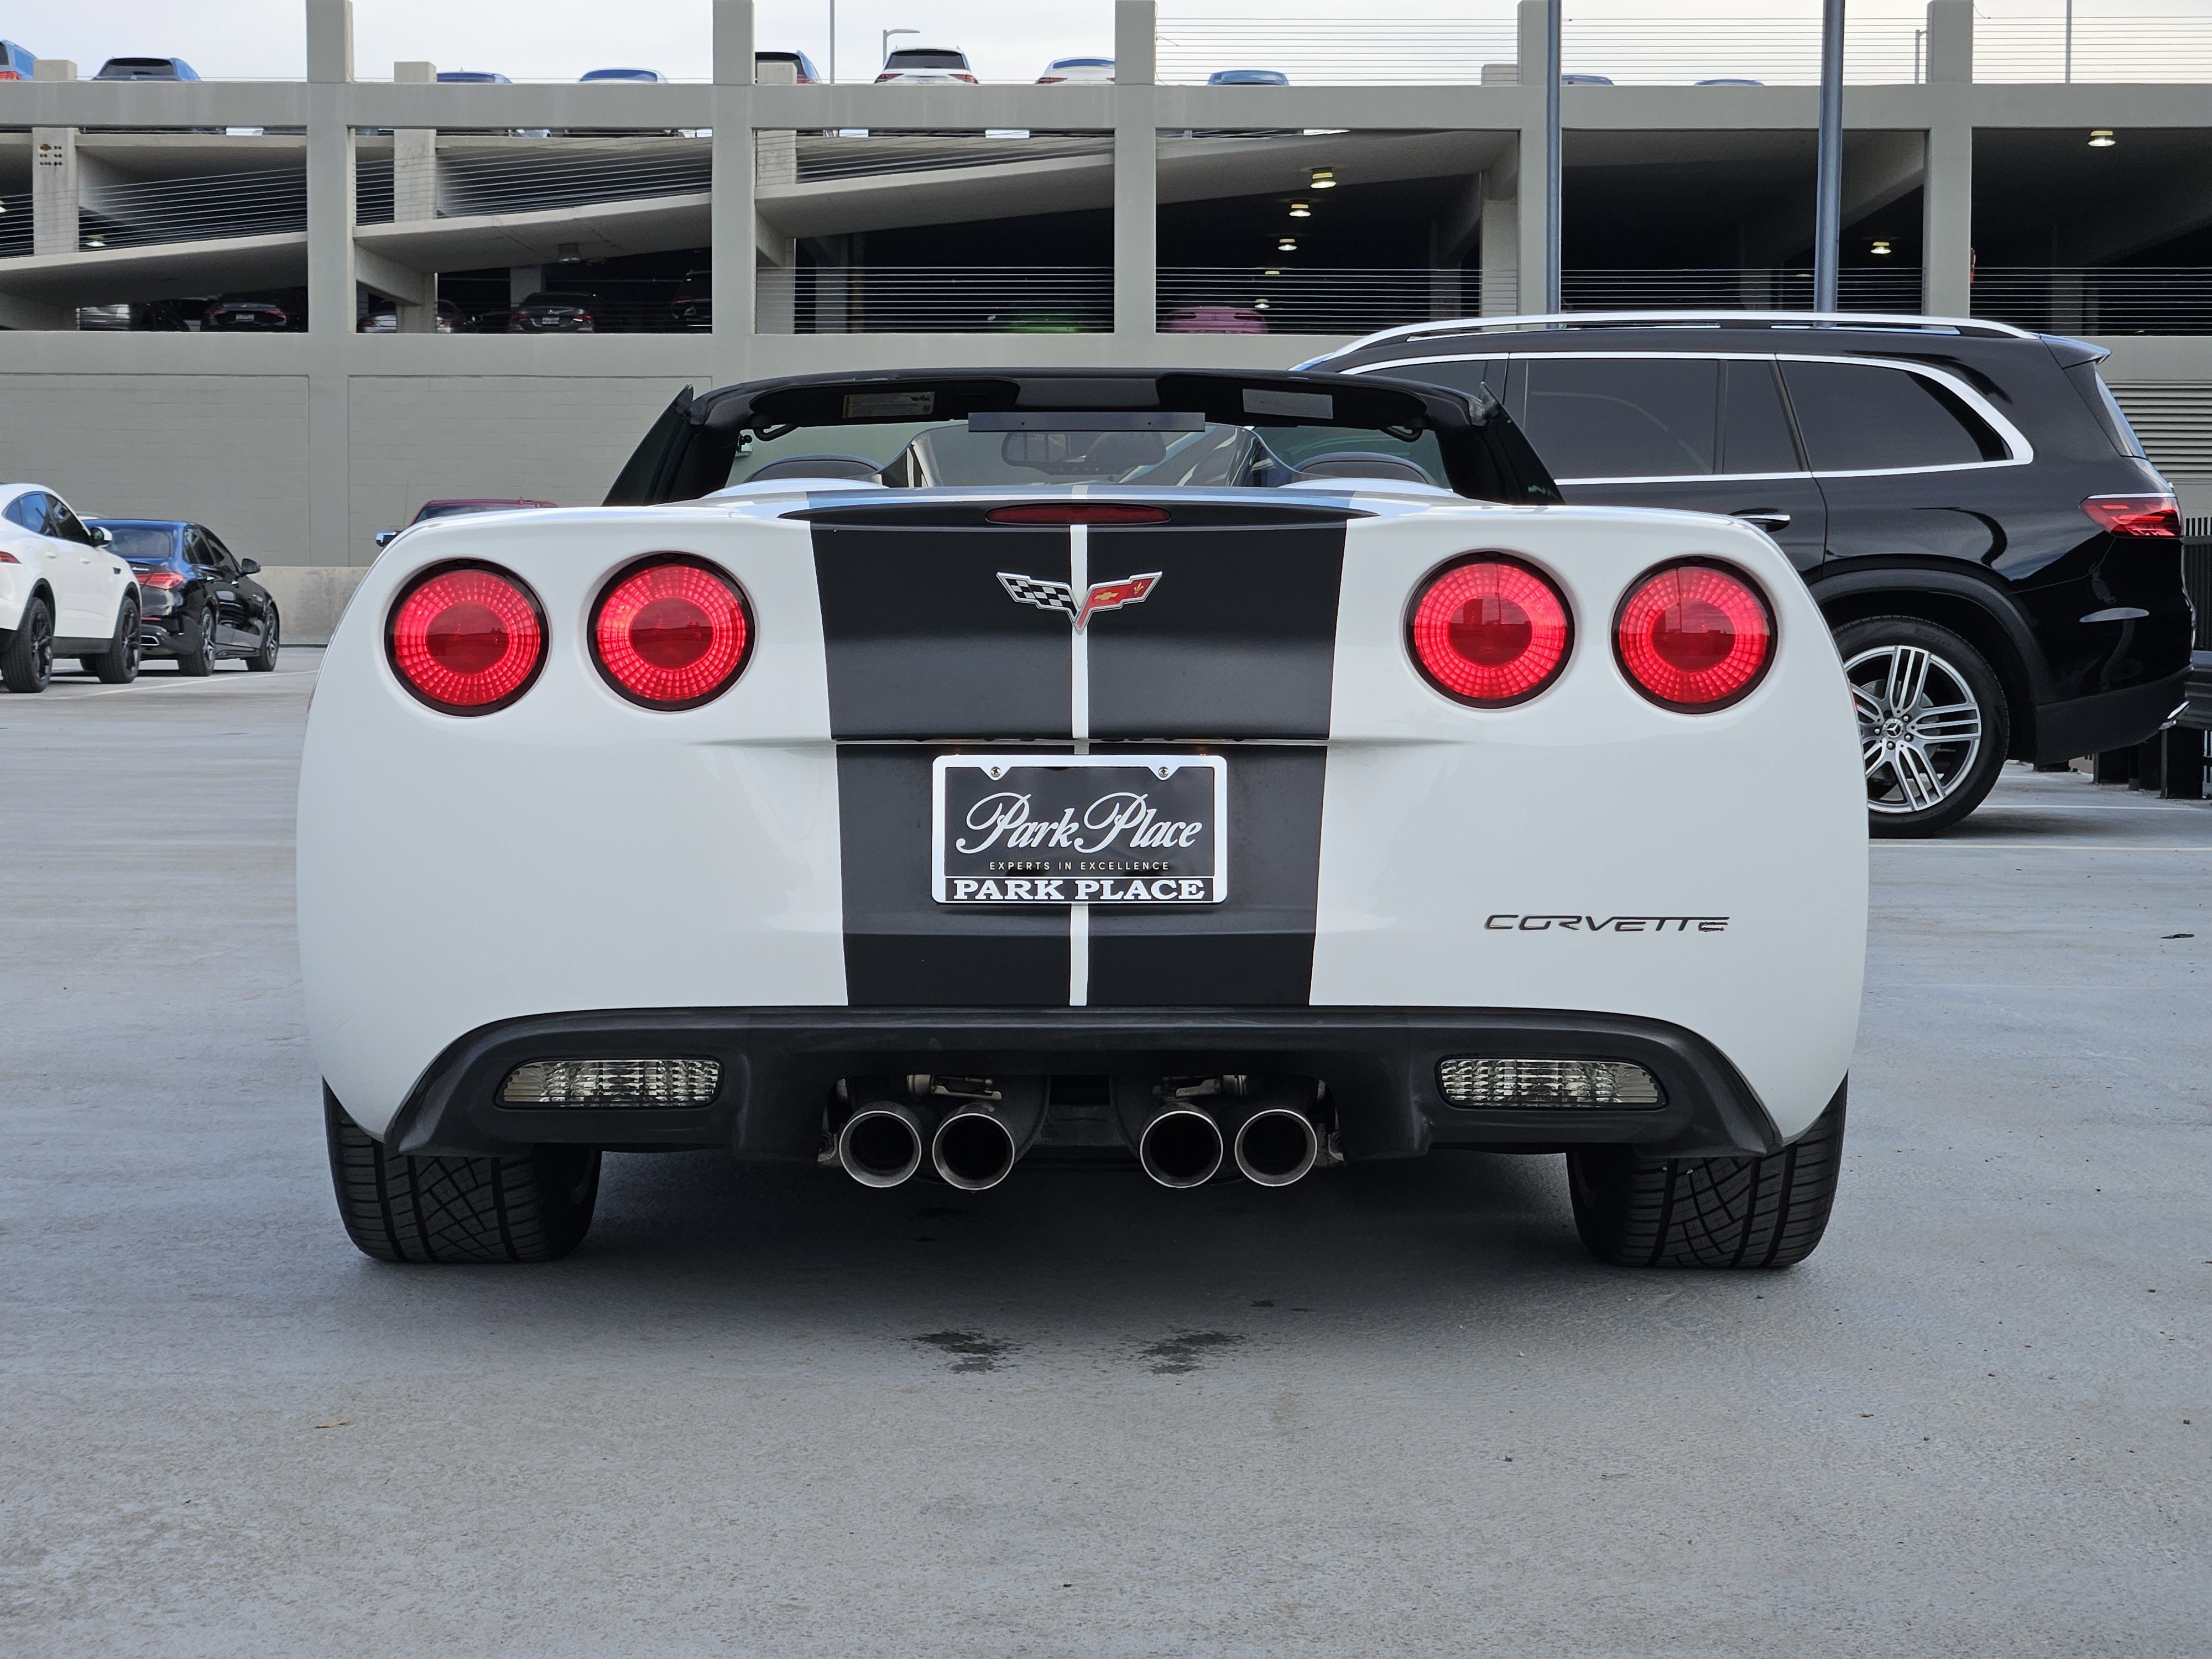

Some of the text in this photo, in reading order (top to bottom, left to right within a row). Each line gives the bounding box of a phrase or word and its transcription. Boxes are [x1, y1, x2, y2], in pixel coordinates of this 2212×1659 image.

[956, 792, 1203, 854] Park Place
[989, 861, 1170, 871] EXPERTS IN EXCELLENCE
[953, 879, 1206, 900] PARK PLACE
[1484, 914, 1730, 932] CORVETTE
